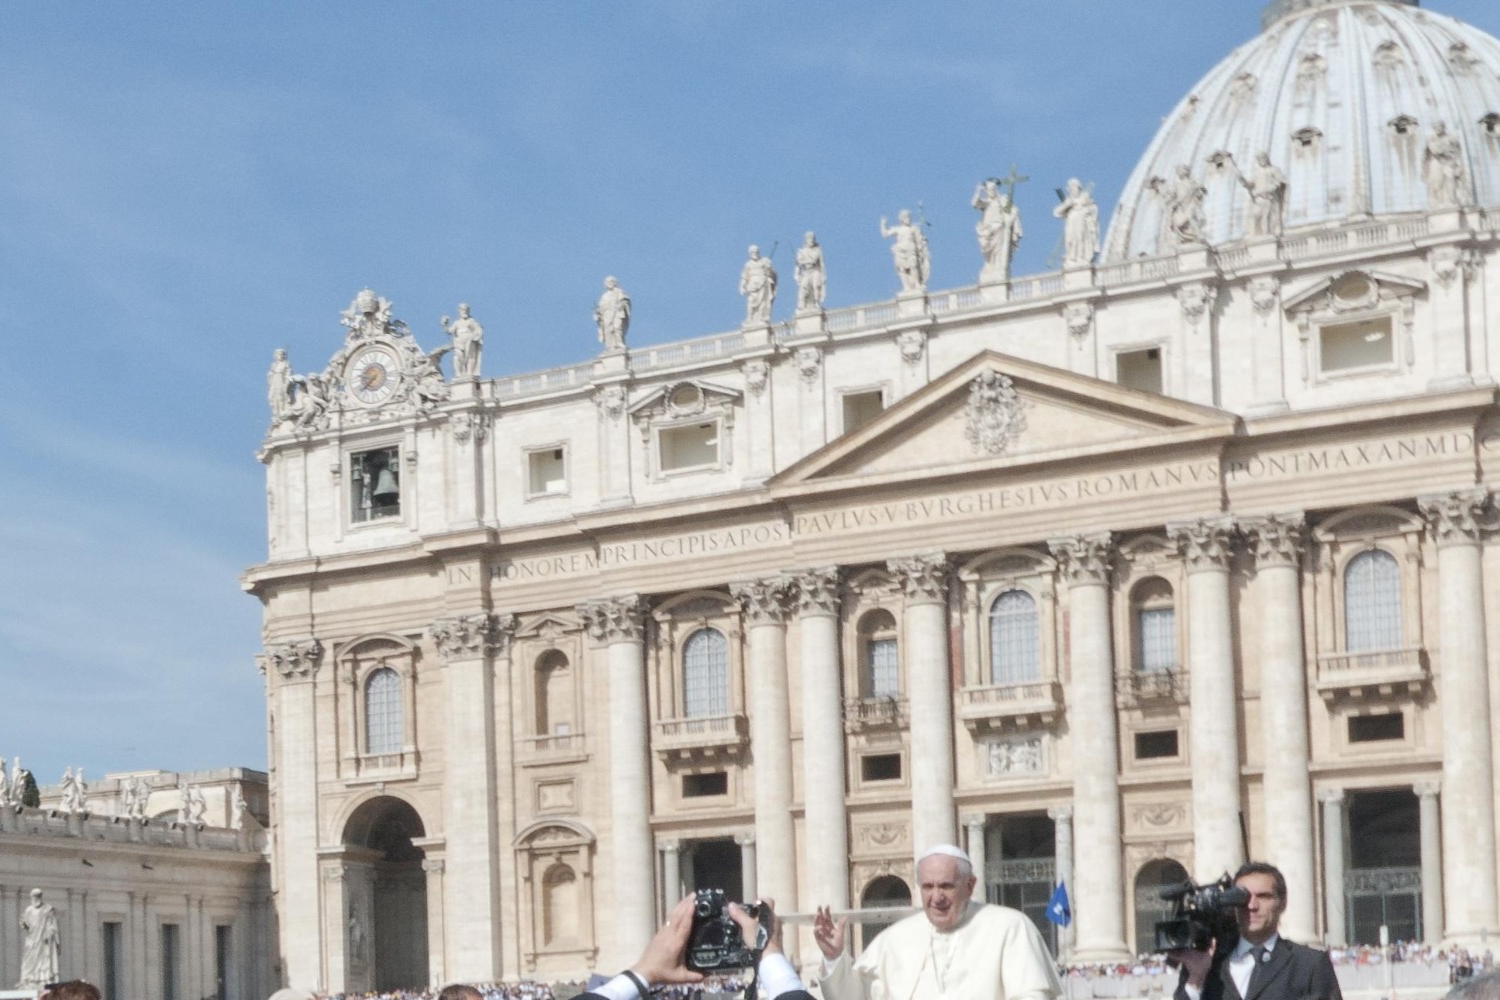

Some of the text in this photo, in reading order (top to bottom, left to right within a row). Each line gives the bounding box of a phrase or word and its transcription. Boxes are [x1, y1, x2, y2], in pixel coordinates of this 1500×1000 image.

[447, 565, 473, 585] IN
[489, 554, 601, 582] HONOREM
[602, 532, 719, 564] PRINCIPIS
[797, 509, 878, 535] PAVLVS
[906, 482, 1068, 521] BVRGHESIVS
[1077, 462, 1219, 498] ROMANVS
